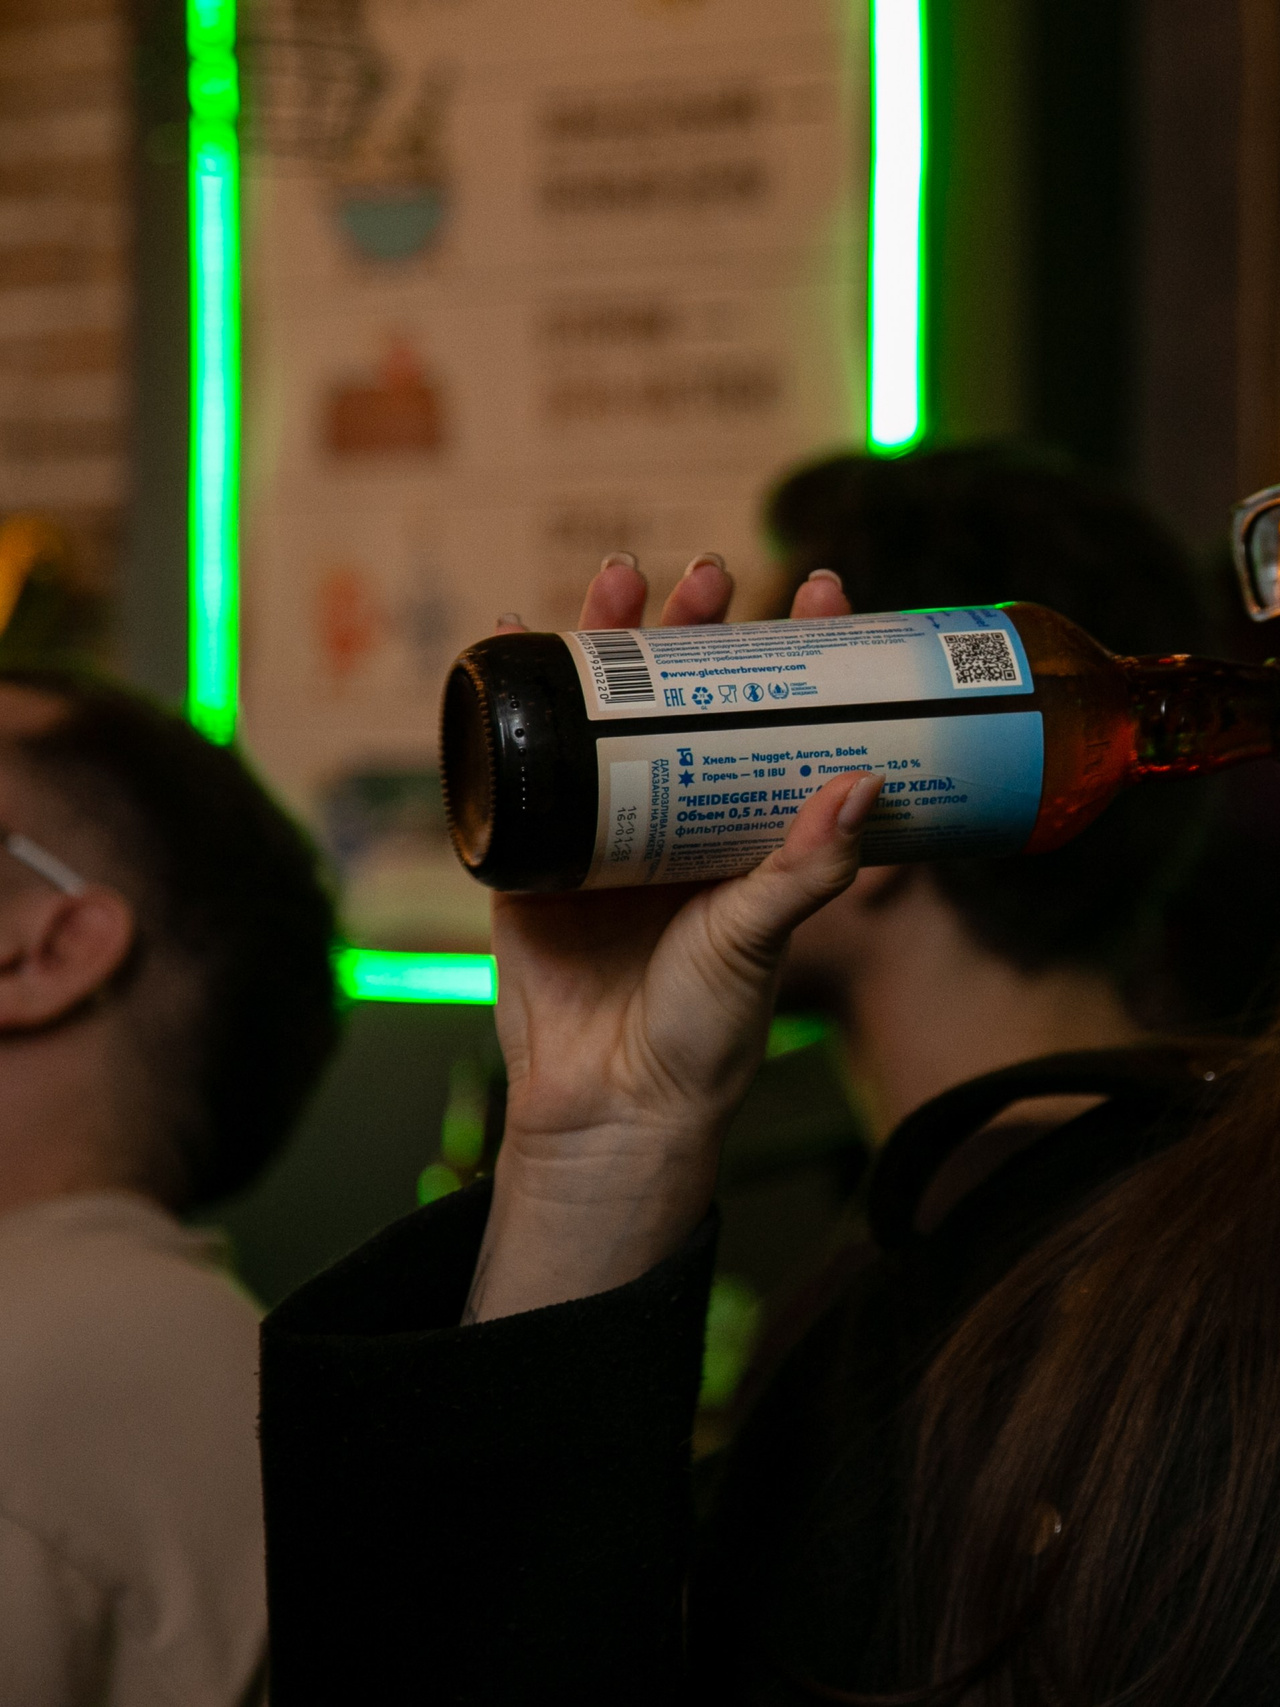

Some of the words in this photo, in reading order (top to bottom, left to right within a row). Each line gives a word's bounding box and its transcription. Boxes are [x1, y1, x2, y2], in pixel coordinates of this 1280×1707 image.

[656, 657, 711, 665] Соответствует
[669, 663, 806, 678] www.gletcherbrewery.com
[702, 755, 737, 766] Хмель
[751, 751, 794, 763] Nugget,
[796, 748, 834, 759] Aurora,
[835, 746, 868, 757] Bobek
[659, 759, 670, 784] ДАТА
[817, 762, 873, 774] Плотность
[887, 760, 908, 770] 12,0
[910, 758, 921, 768] %
[651, 759, 660, 806] УКАЗАНЫ
[702, 772, 738, 783] Горечь
[753, 768, 765, 778] 18
[767, 767, 786, 777] IBU
[908, 776, 956, 792] ХЕЛЬ).
[650, 808, 659, 821] НА
[658, 786, 670, 829] РОЗЛИВА
[676, 809, 725, 822] Объем
[728, 807, 750, 819] 0,5
[753, 807, 767, 817] л.
[875, 796, 911, 809] Пиво
[914, 794, 968, 806] светлое
[675, 820, 784, 837] фильтрованное
